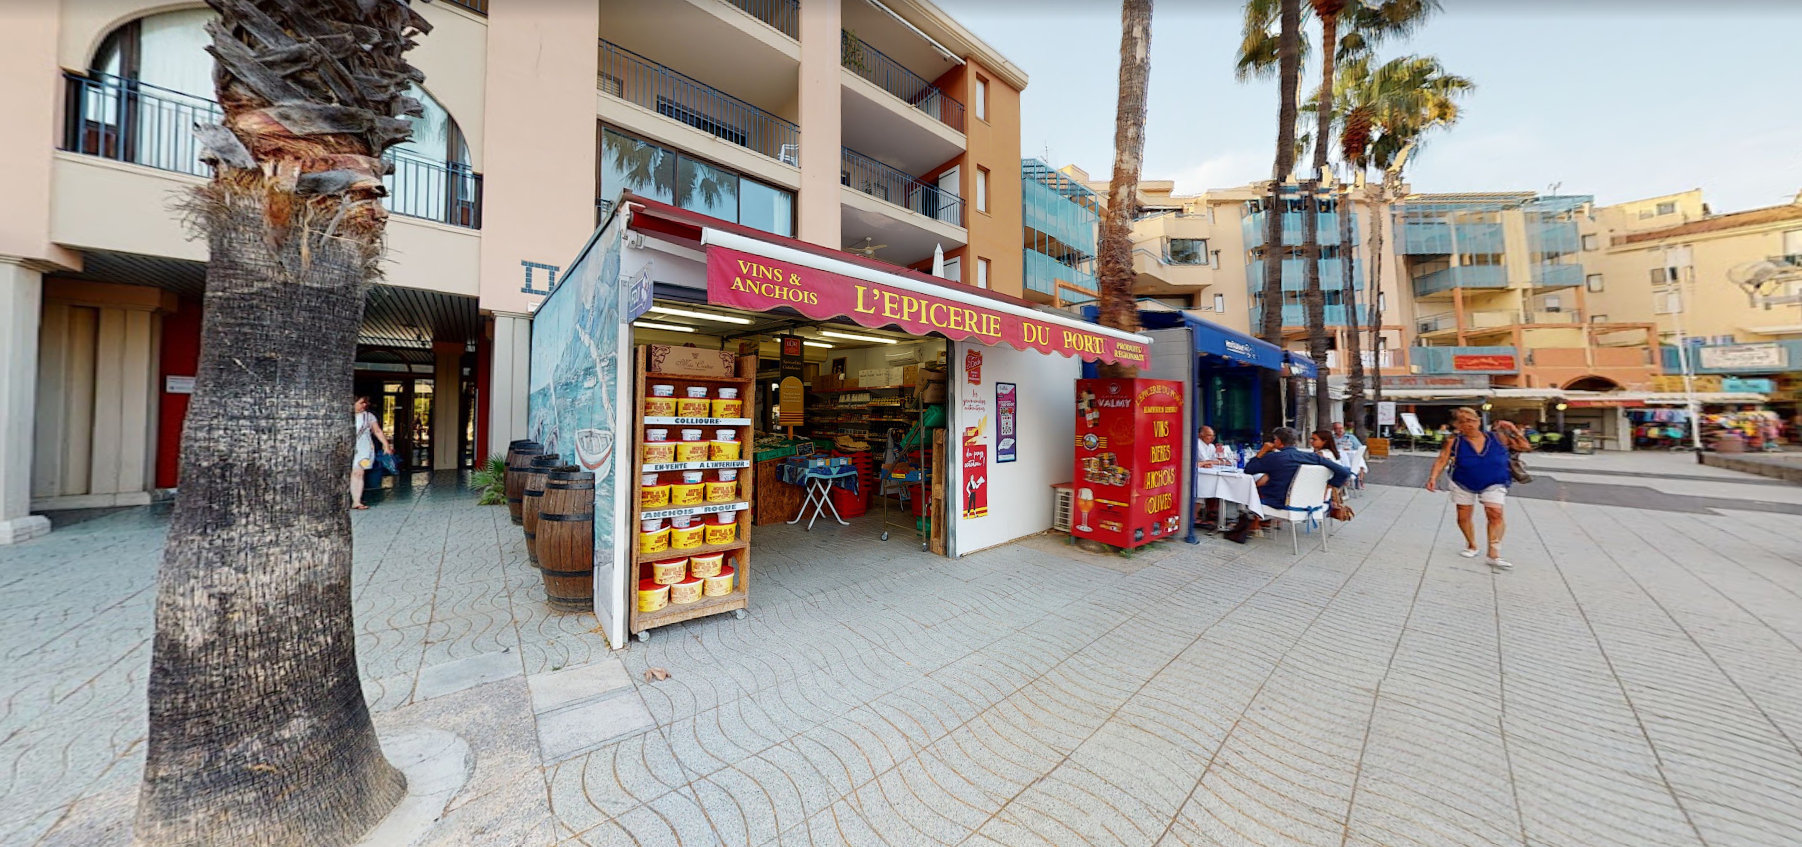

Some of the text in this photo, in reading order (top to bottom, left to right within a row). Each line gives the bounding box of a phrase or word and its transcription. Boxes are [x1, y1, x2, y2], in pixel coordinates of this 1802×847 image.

[736, 259, 801, 286] VINS &
[730, 276, 818, 305] ANCHOIS
[854, 284, 1002, 337] L'EPICERIE
[1022, 321, 1050, 346] DU
[1097, 398, 1132, 408] VALMY
[1153, 420, 1170, 438] VINS
[643, 504, 737, 519] ANCHOIS ROQUE
[1146, 493, 1172, 514] OLIVES
